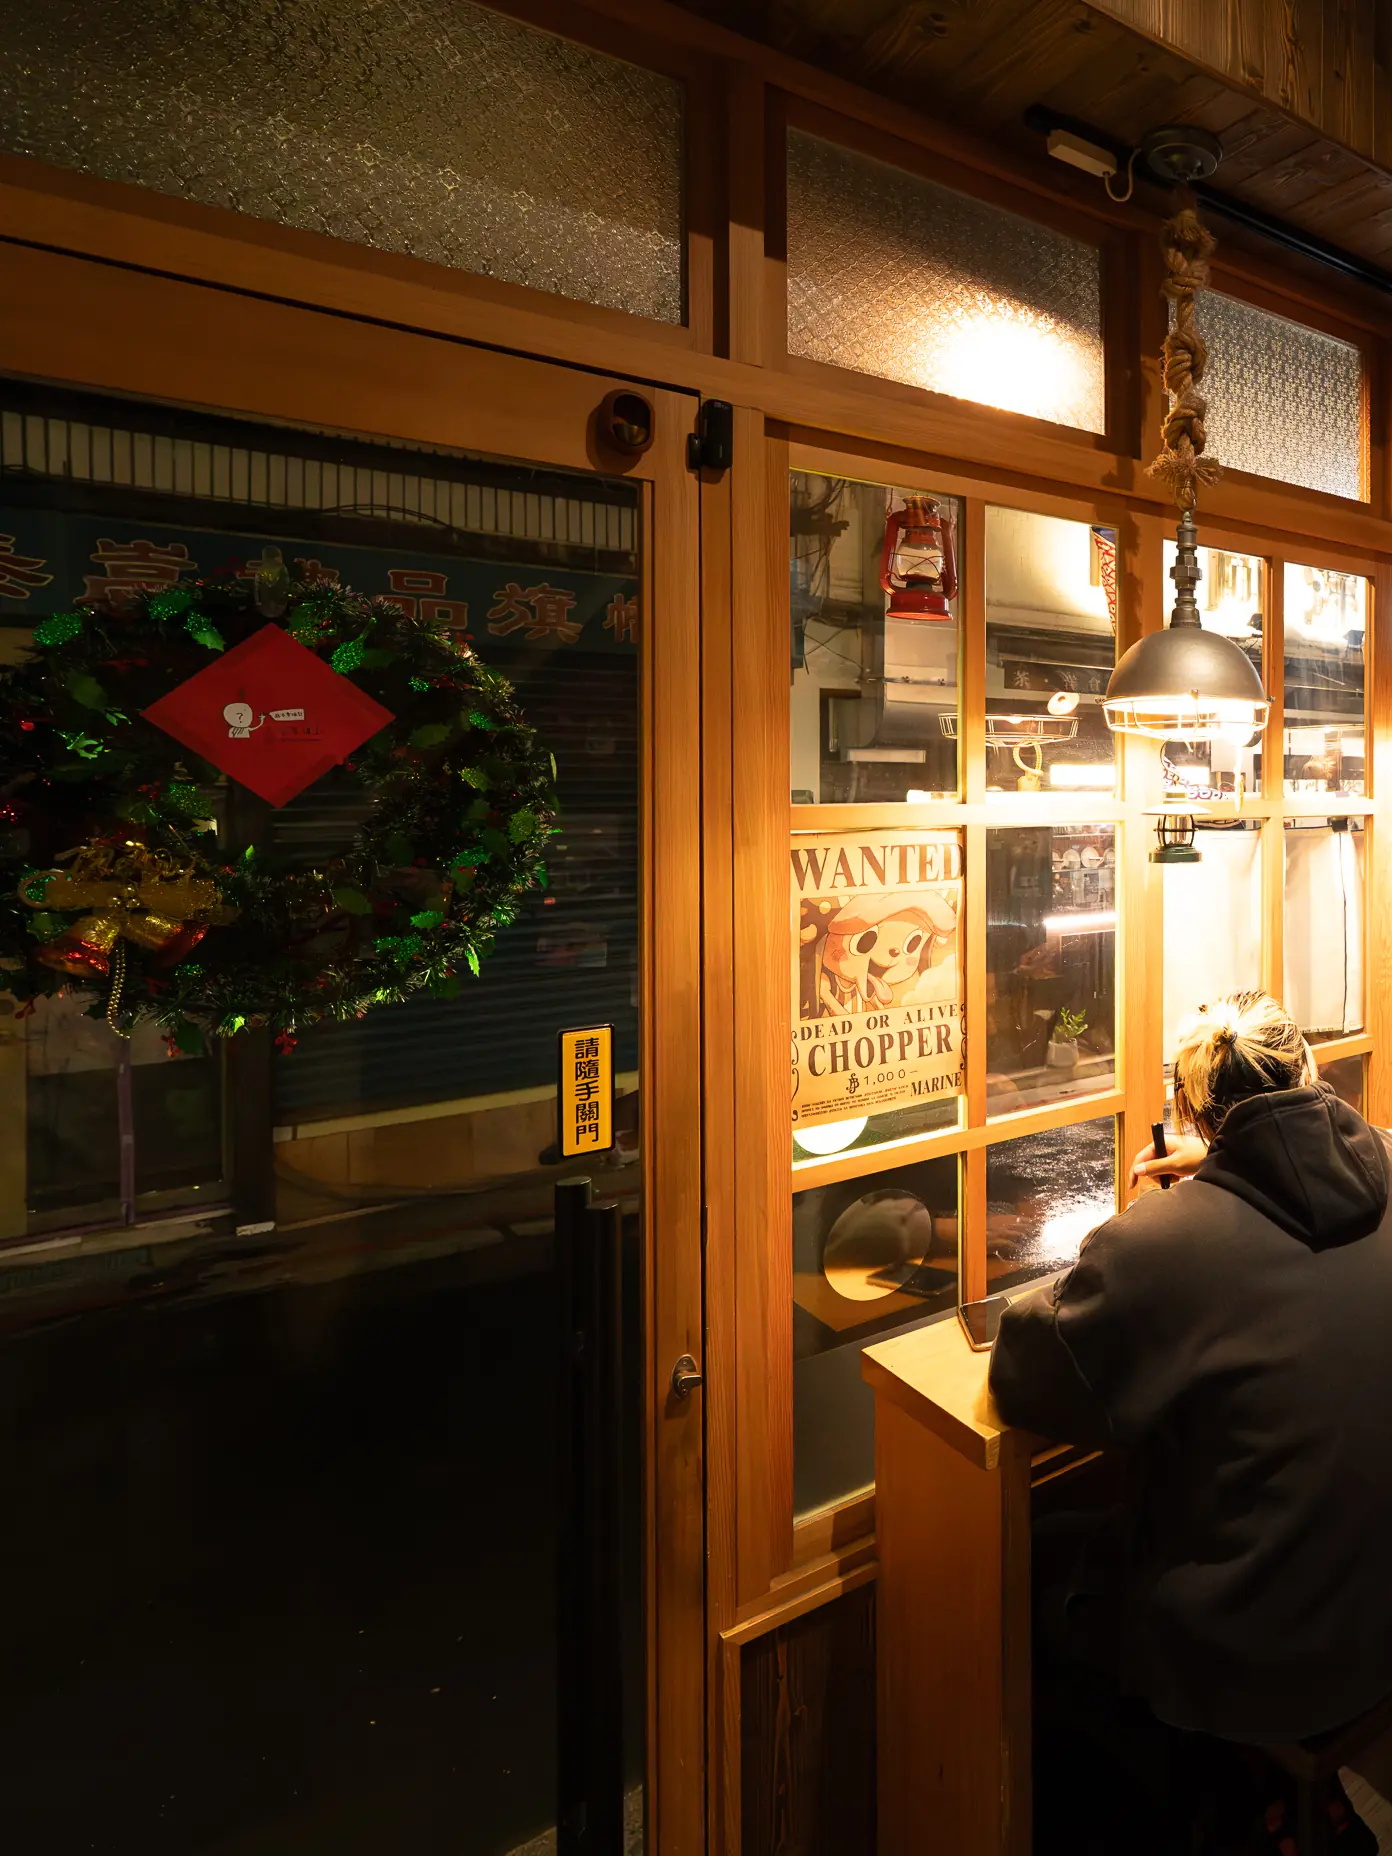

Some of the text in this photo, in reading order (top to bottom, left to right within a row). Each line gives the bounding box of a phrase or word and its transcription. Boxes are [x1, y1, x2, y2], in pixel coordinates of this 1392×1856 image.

[790, 842, 964, 892] WANTED
[800, 1003, 958, 1041] DEAD OR ALIVE
[807, 1023, 954, 1077] CHOPPER
[574, 1037, 600, 1146] 請隨手關門
[910, 1071, 963, 1097] MARINE
